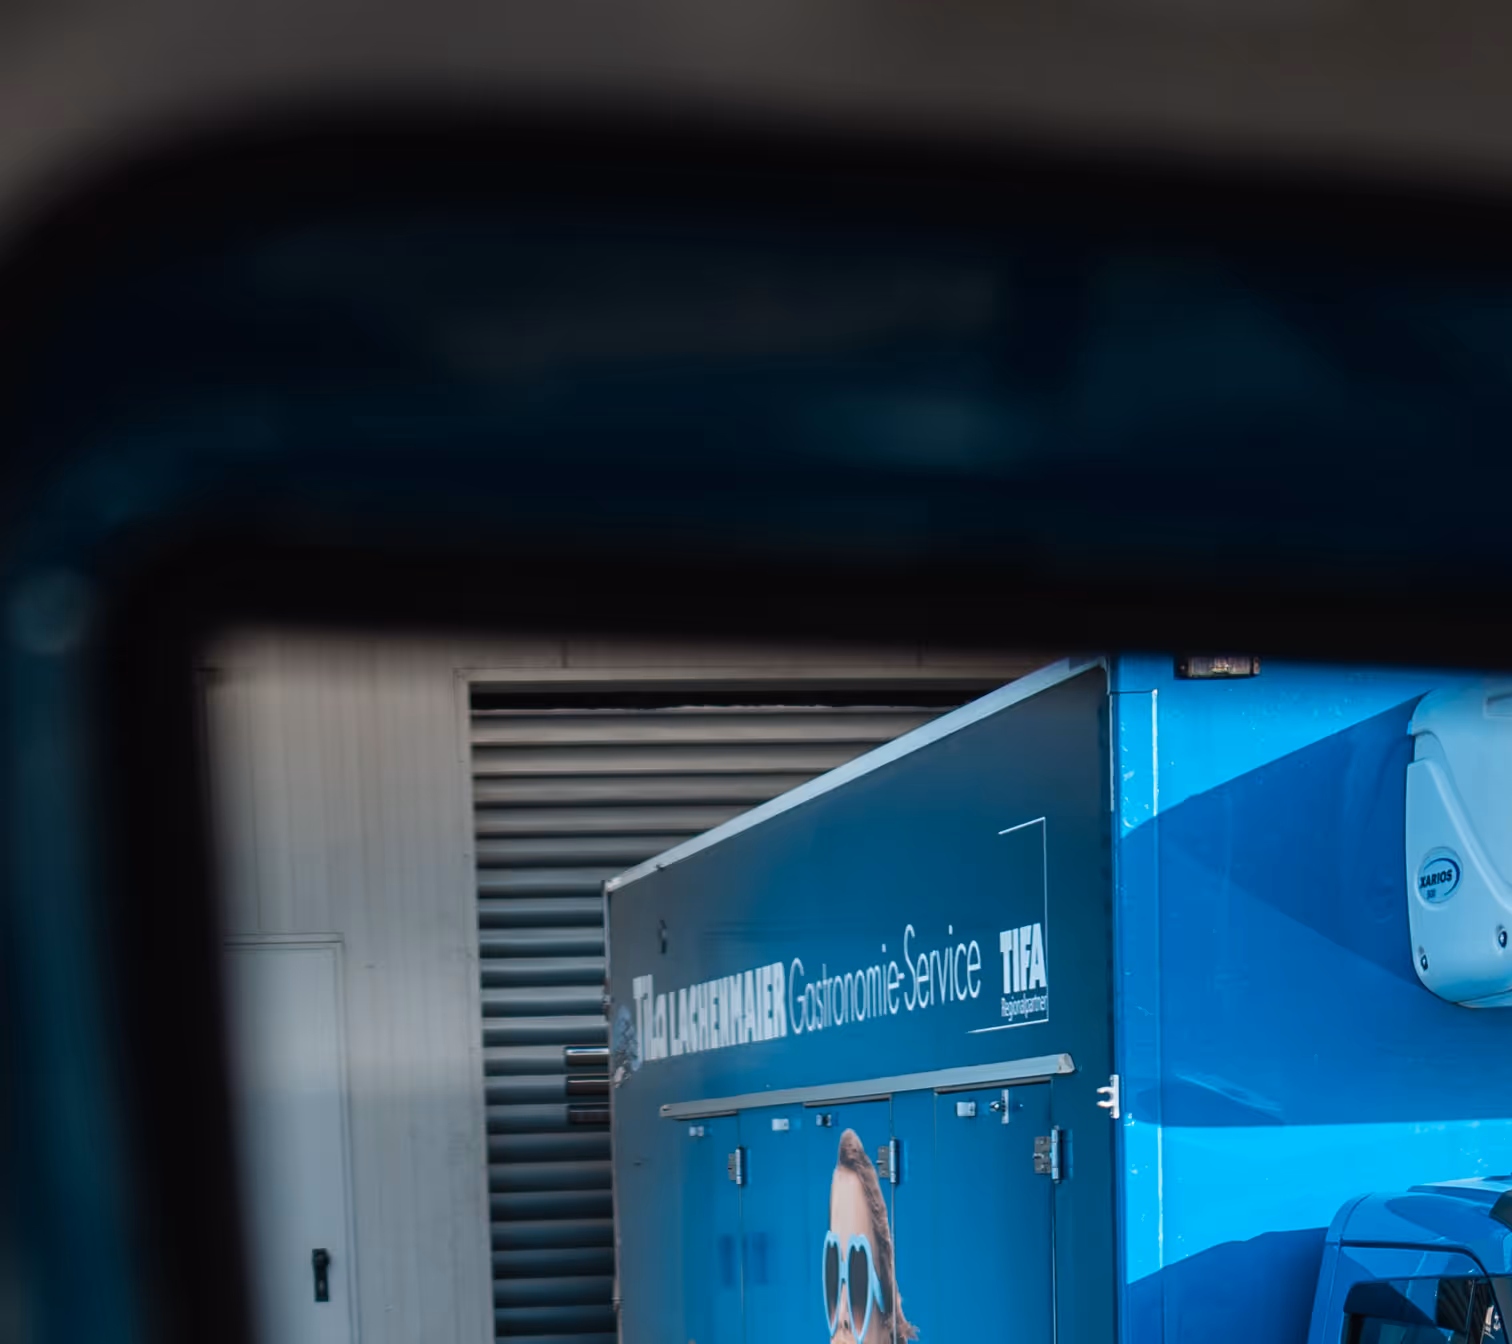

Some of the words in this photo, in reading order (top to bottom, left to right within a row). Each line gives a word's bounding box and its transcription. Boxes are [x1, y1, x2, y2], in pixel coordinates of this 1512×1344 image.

[669, 962, 787, 1056] LACHENMAIER
[788, 924, 981, 1034] Gastronomie-Service
[1000, 923, 1047, 994] TIFA
